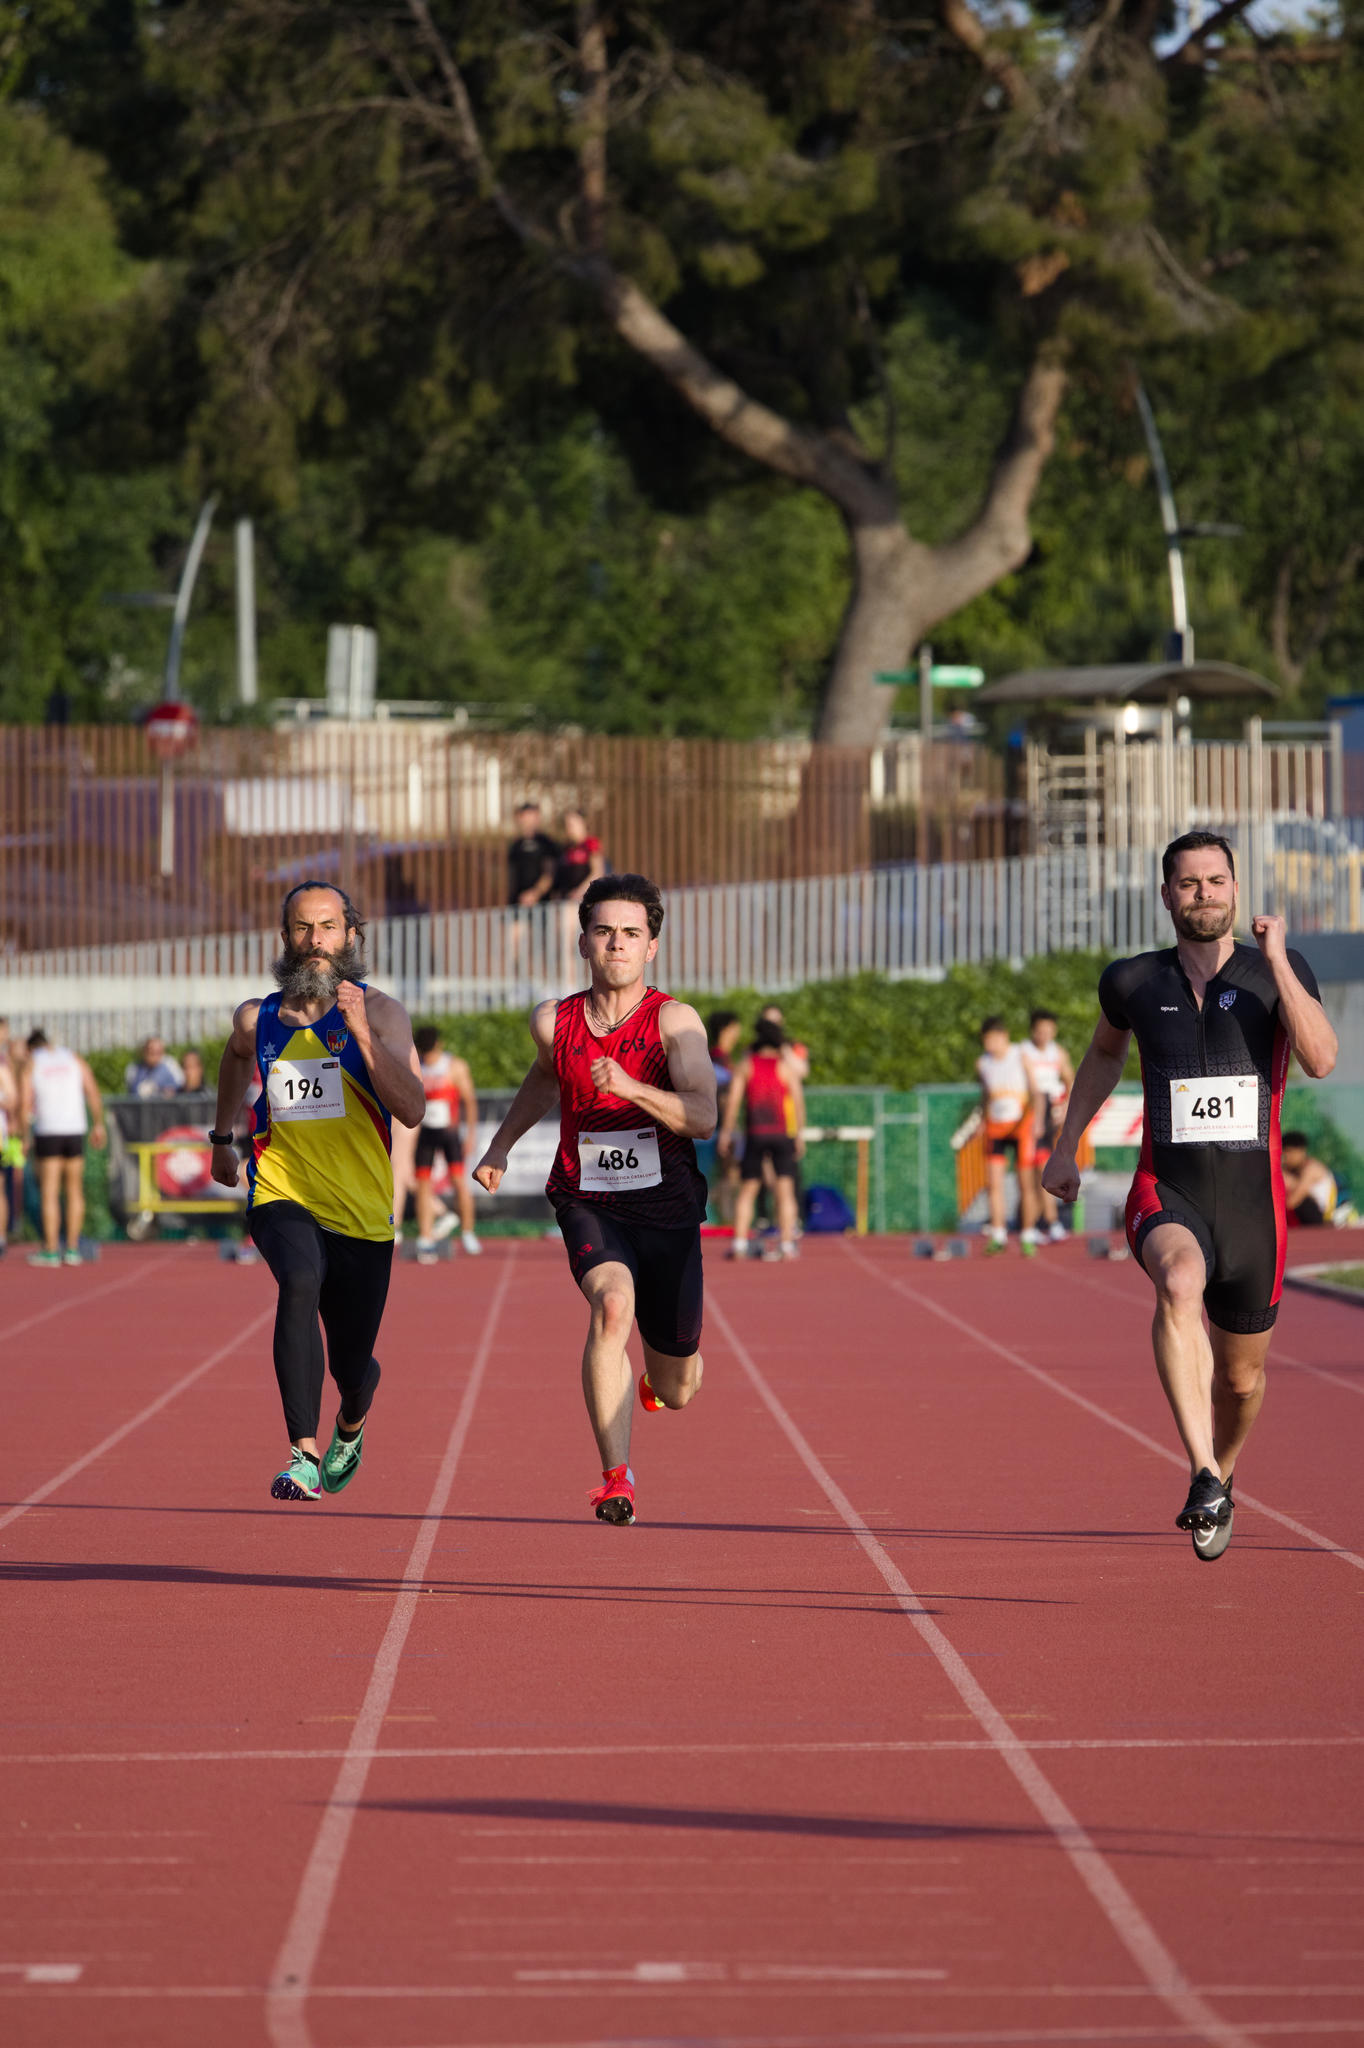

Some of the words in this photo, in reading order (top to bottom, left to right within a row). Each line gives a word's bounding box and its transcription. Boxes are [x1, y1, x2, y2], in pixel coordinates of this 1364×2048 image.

[284, 1077, 323, 1100] 196
[1191, 1096, 1234, 1119] 481
[598, 1148, 639, 1171] 486
